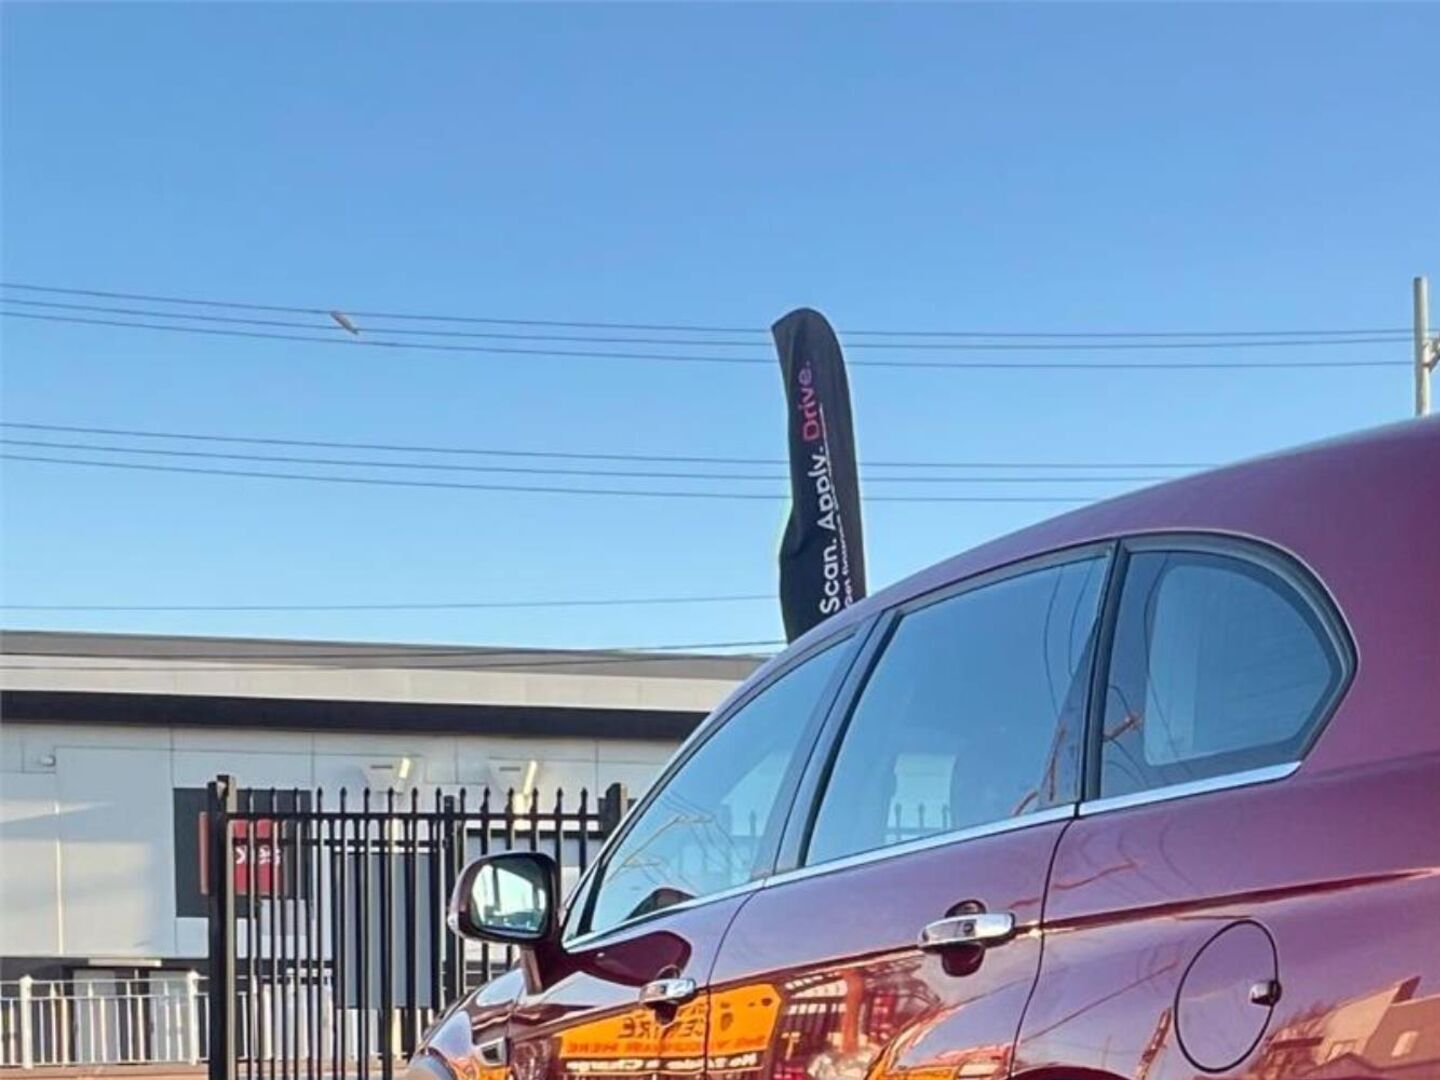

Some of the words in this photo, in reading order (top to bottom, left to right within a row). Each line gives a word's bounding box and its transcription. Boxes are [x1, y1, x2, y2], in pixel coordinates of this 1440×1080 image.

[797, 359, 820, 443] Drive.
[807, 445, 838, 530] Apply.
[820, 538, 841, 614] Scan.
